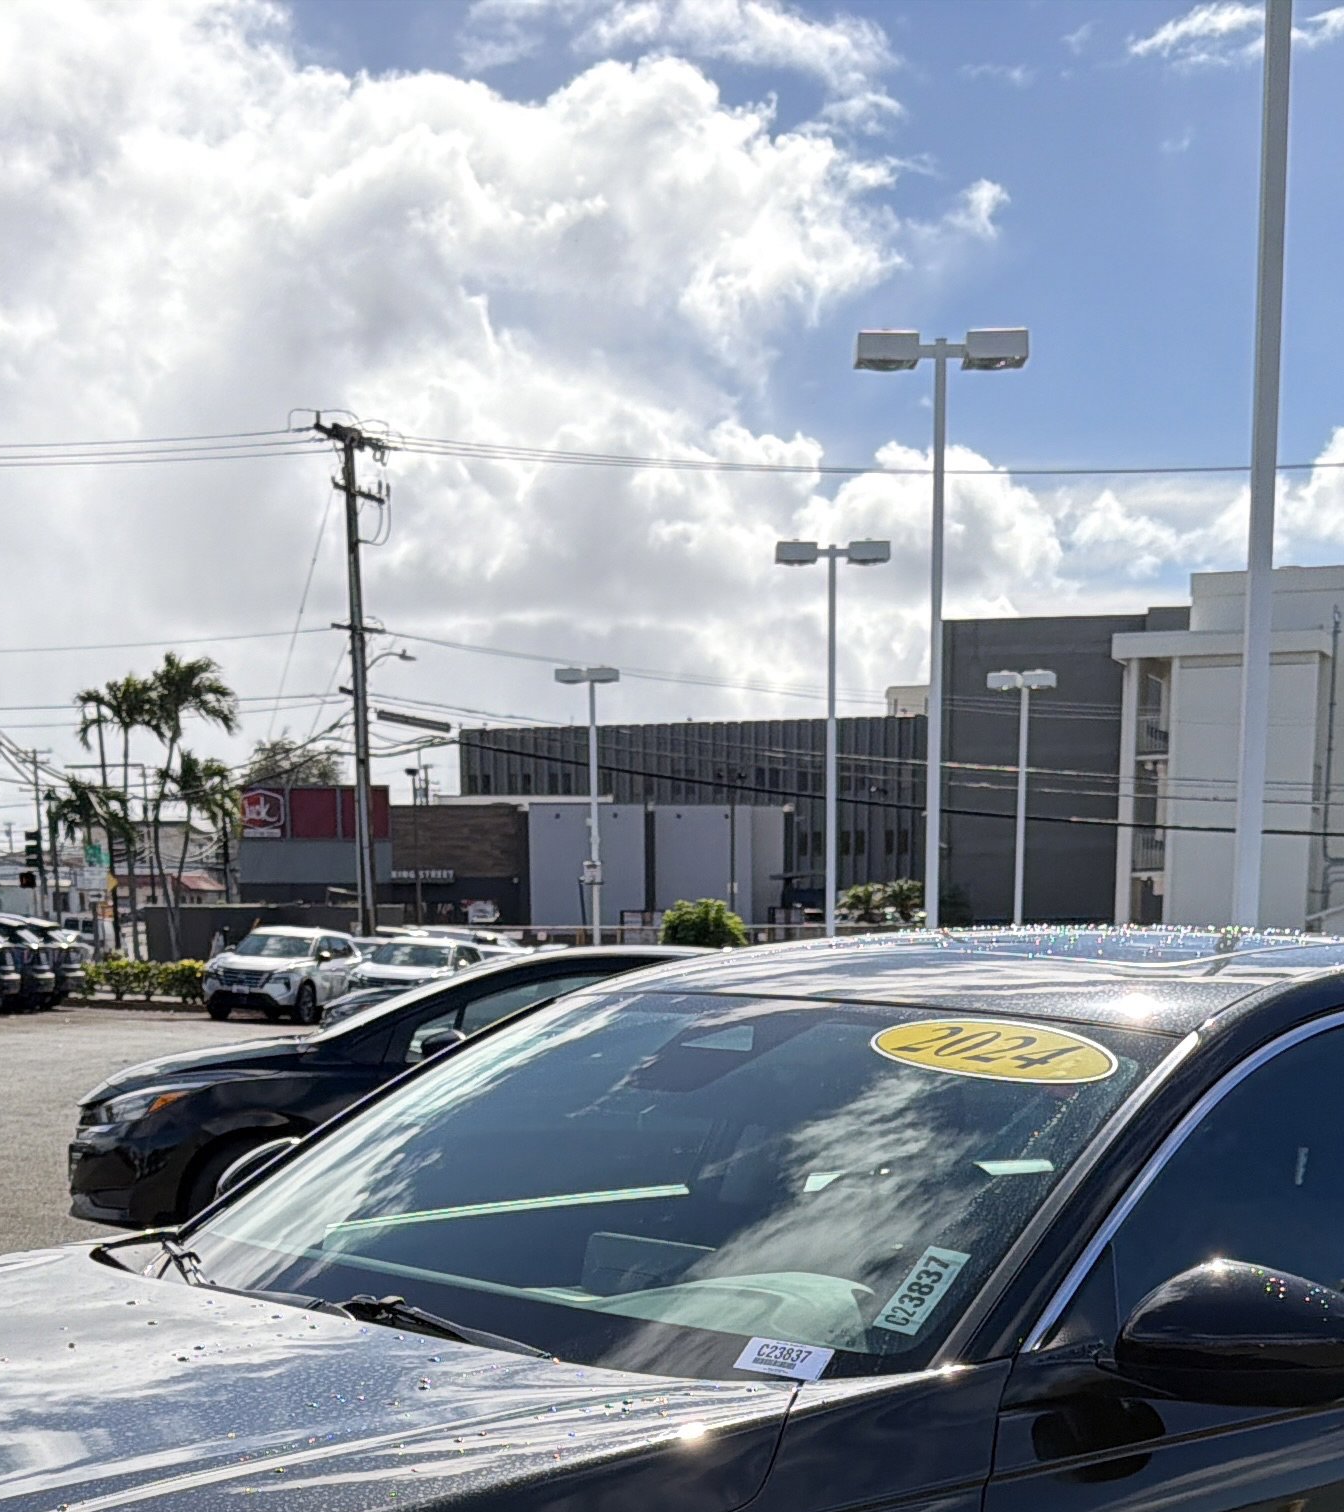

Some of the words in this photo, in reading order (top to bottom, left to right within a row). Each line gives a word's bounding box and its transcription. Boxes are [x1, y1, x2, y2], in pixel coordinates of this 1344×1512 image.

[418, 869, 455, 879] STREET
[890, 1026, 1085, 1070] 2024
[884, 1255, 950, 1327] C23837
[757, 1343, 813, 1364] C23837
